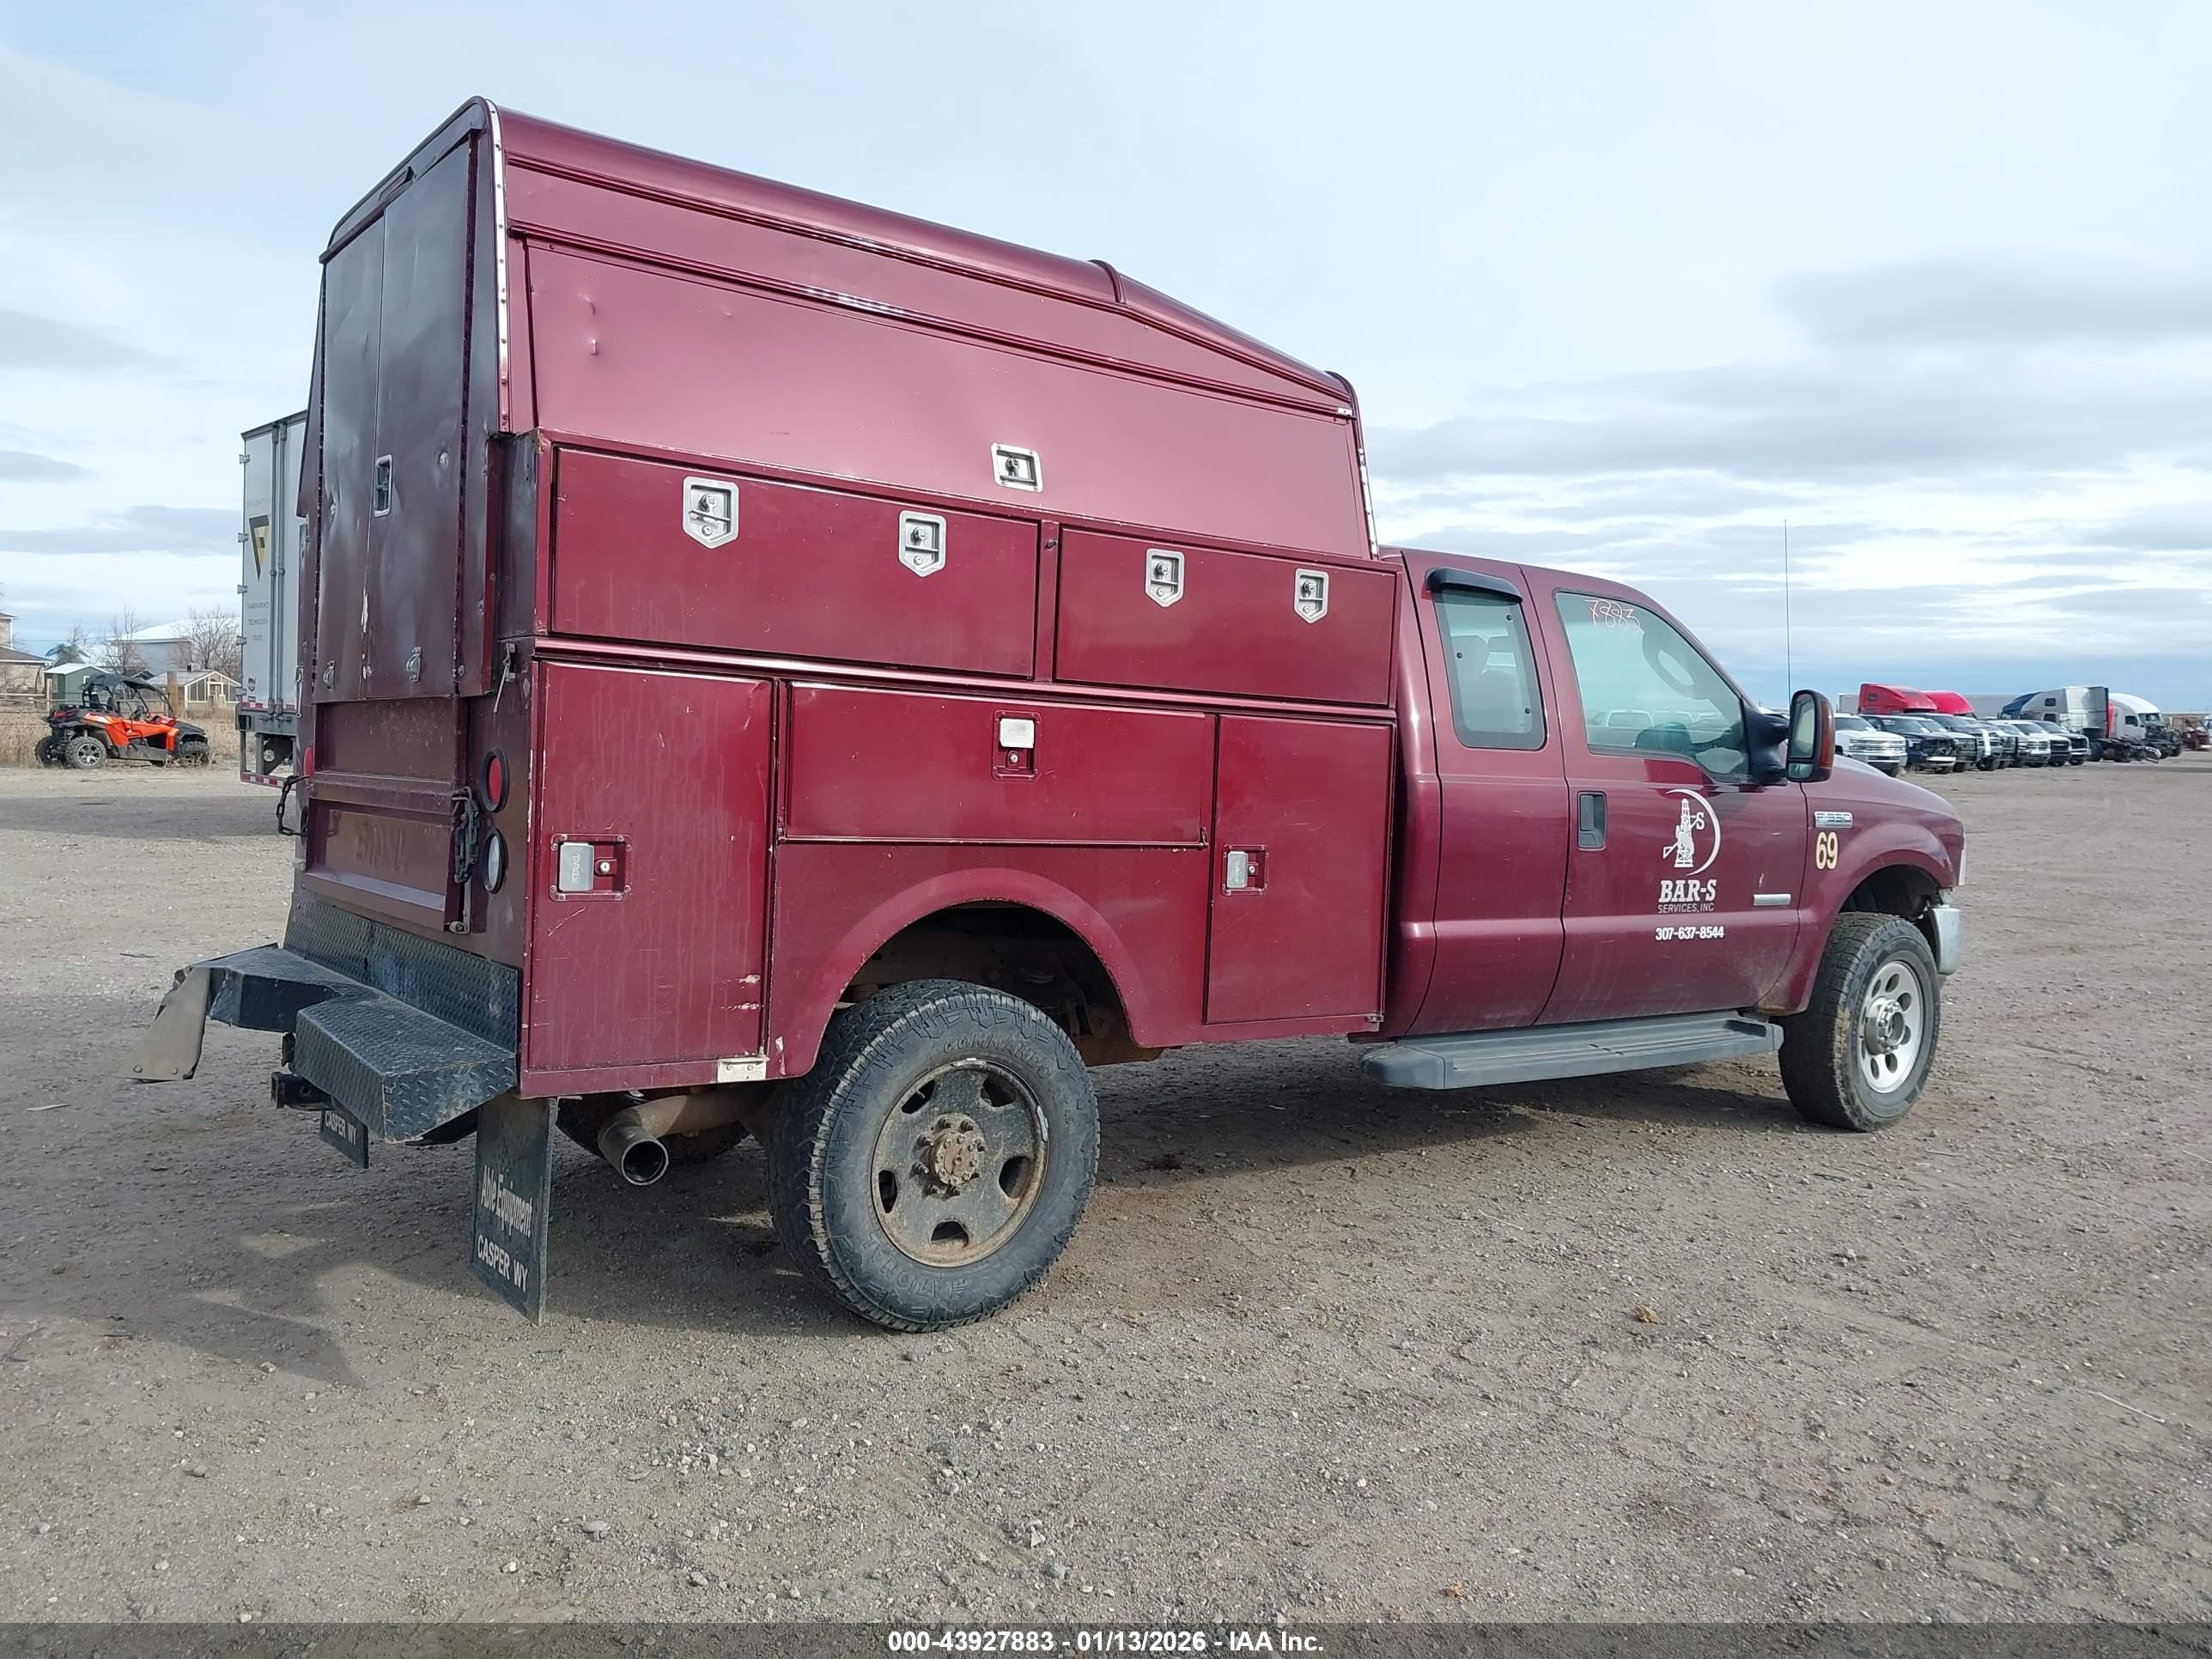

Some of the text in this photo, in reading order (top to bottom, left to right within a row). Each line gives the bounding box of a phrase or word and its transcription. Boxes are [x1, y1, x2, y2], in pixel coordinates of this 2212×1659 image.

[1815, 831, 1838, 870] 69
[1658, 879, 1717, 903] BAR-S
[1700, 902, 1715, 912] INC
[1655, 926, 1724, 941] 307-637-8544
[481, 1164, 533, 1238] Able Equipment
[477, 1234, 529, 1292] CASPER WY
